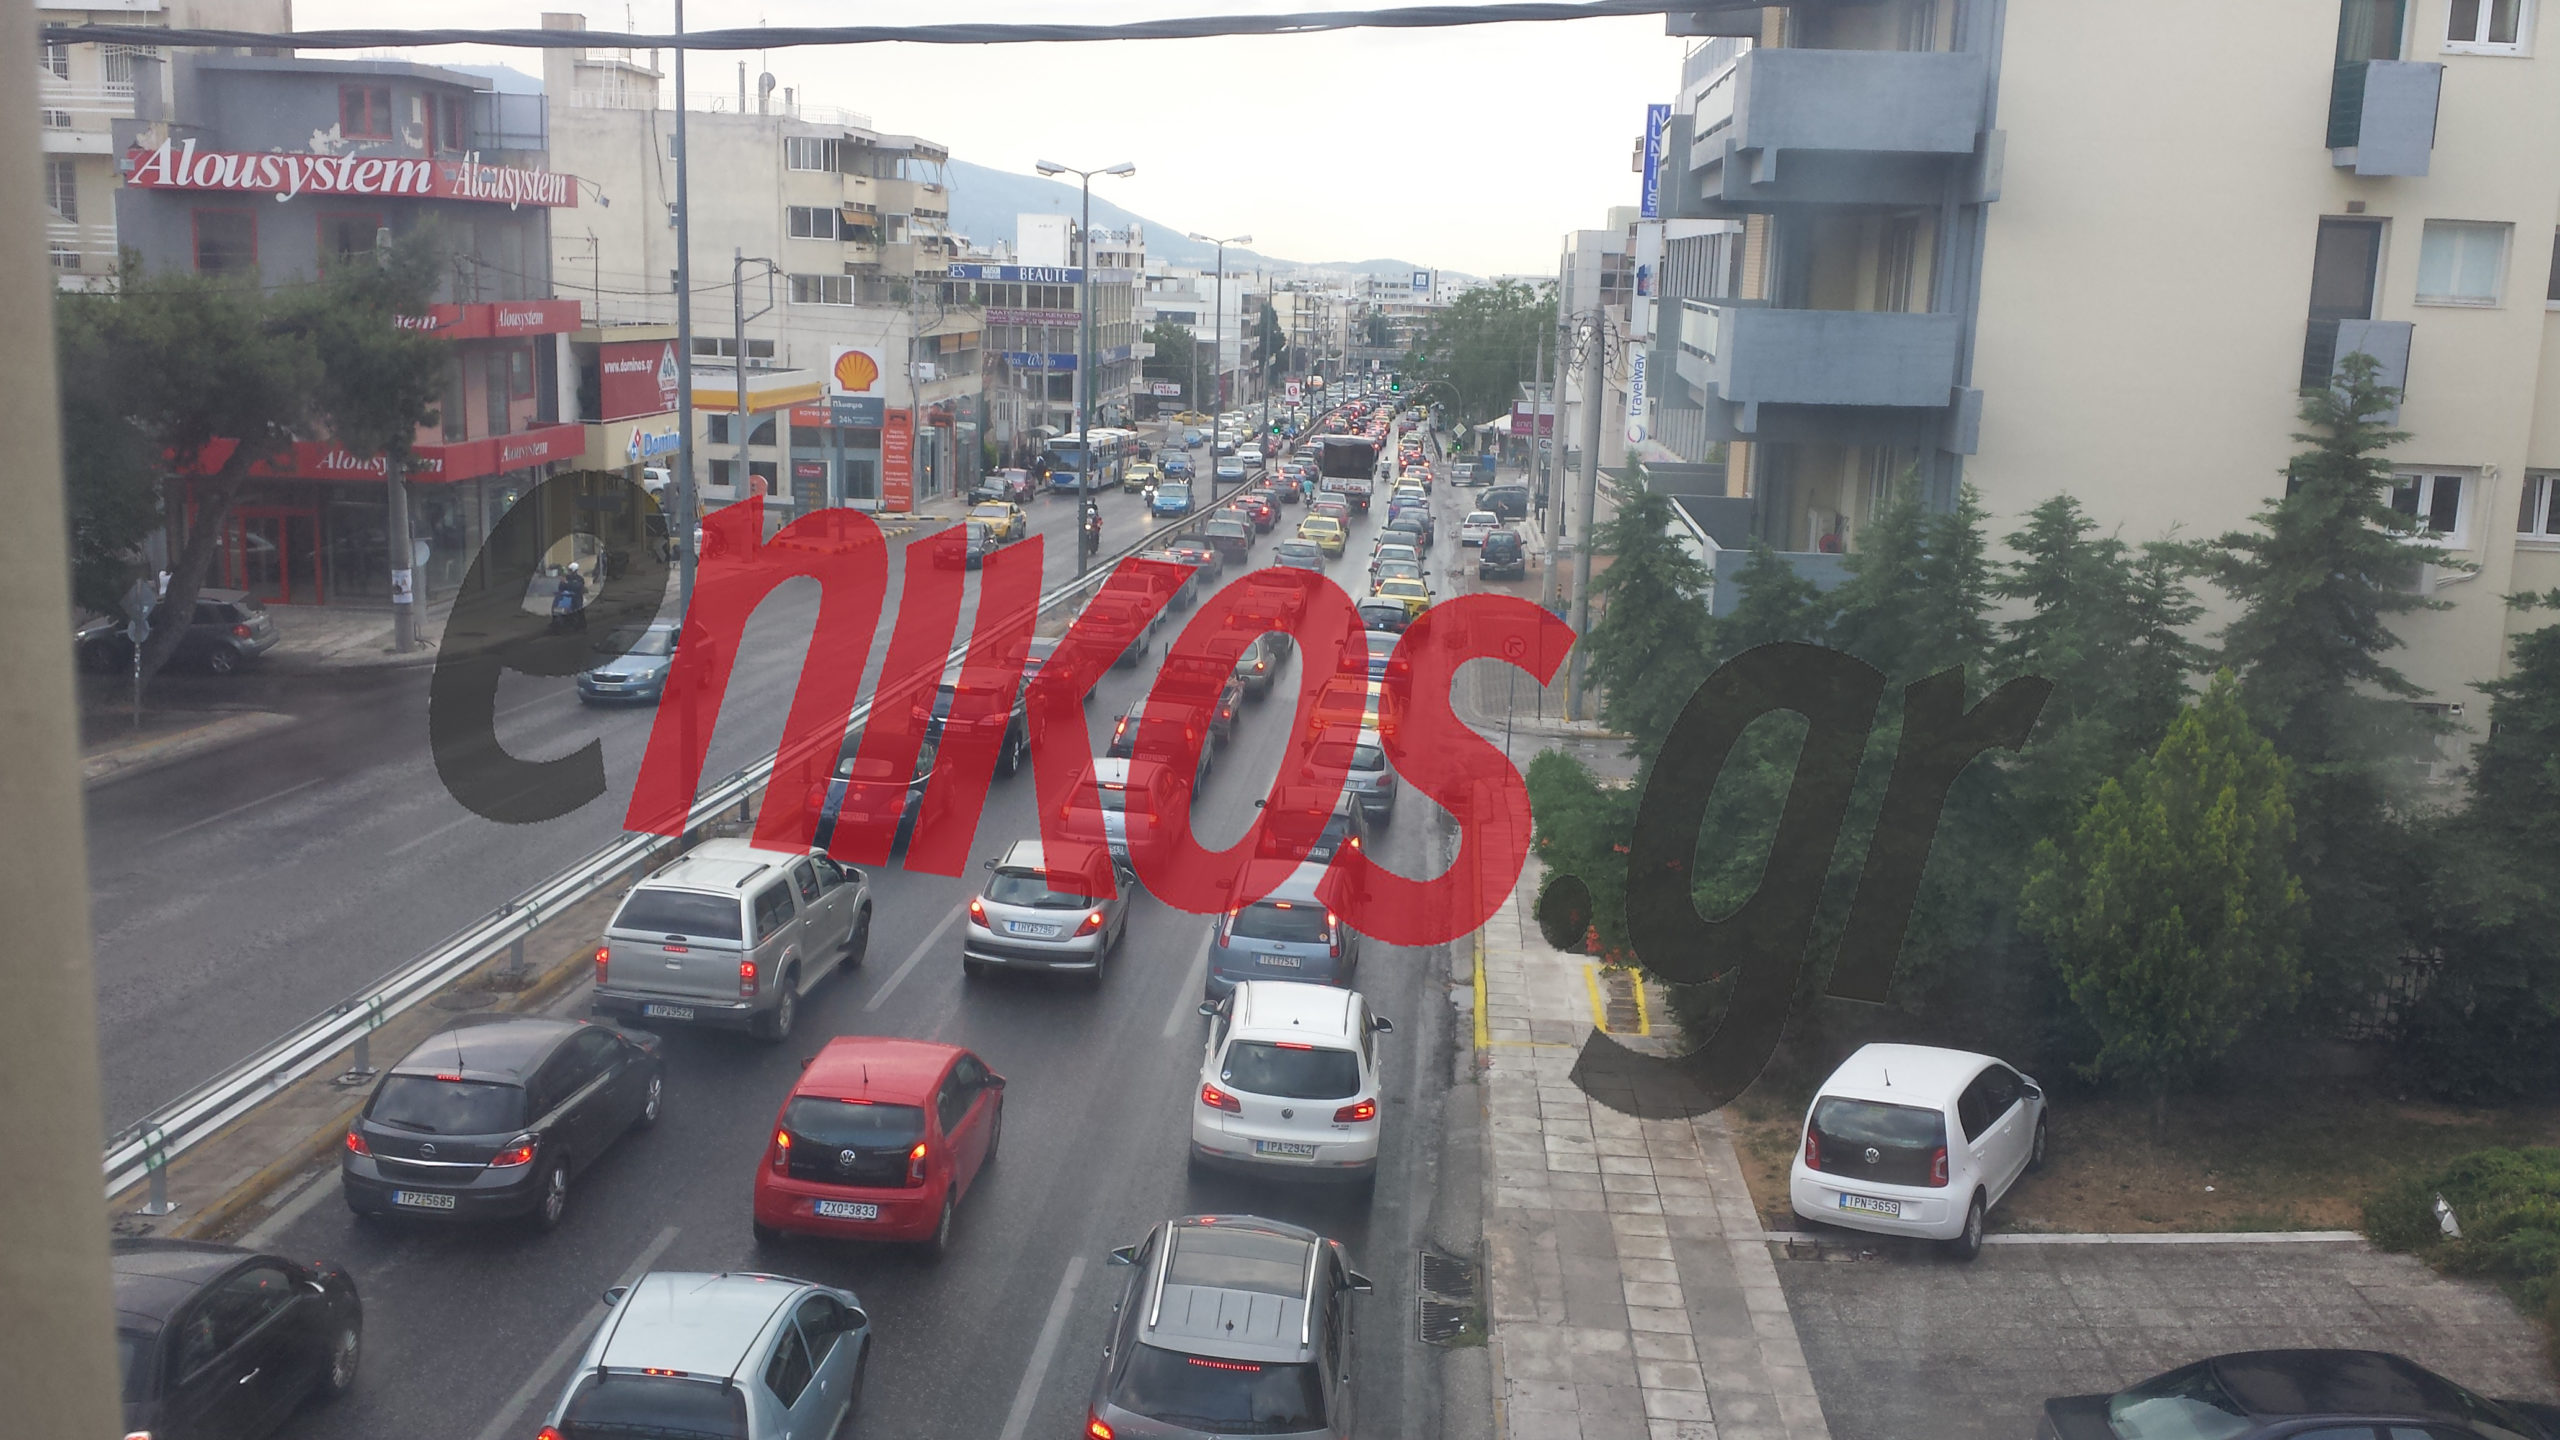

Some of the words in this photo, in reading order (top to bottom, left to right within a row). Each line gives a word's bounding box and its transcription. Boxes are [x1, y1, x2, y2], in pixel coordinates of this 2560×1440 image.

[127, 137, 433, 202] Alousystem
[451, 148, 567, 211] Alousystem
[1020, 267, 1069, 282] BEAUTE
[496, 307, 544, 331] Alousystem
[604, 357, 653, 374] www.dominos.gr
[1629, 353, 1646, 417] travelway
[1849, 1196, 1898, 1213] IPN-3659
